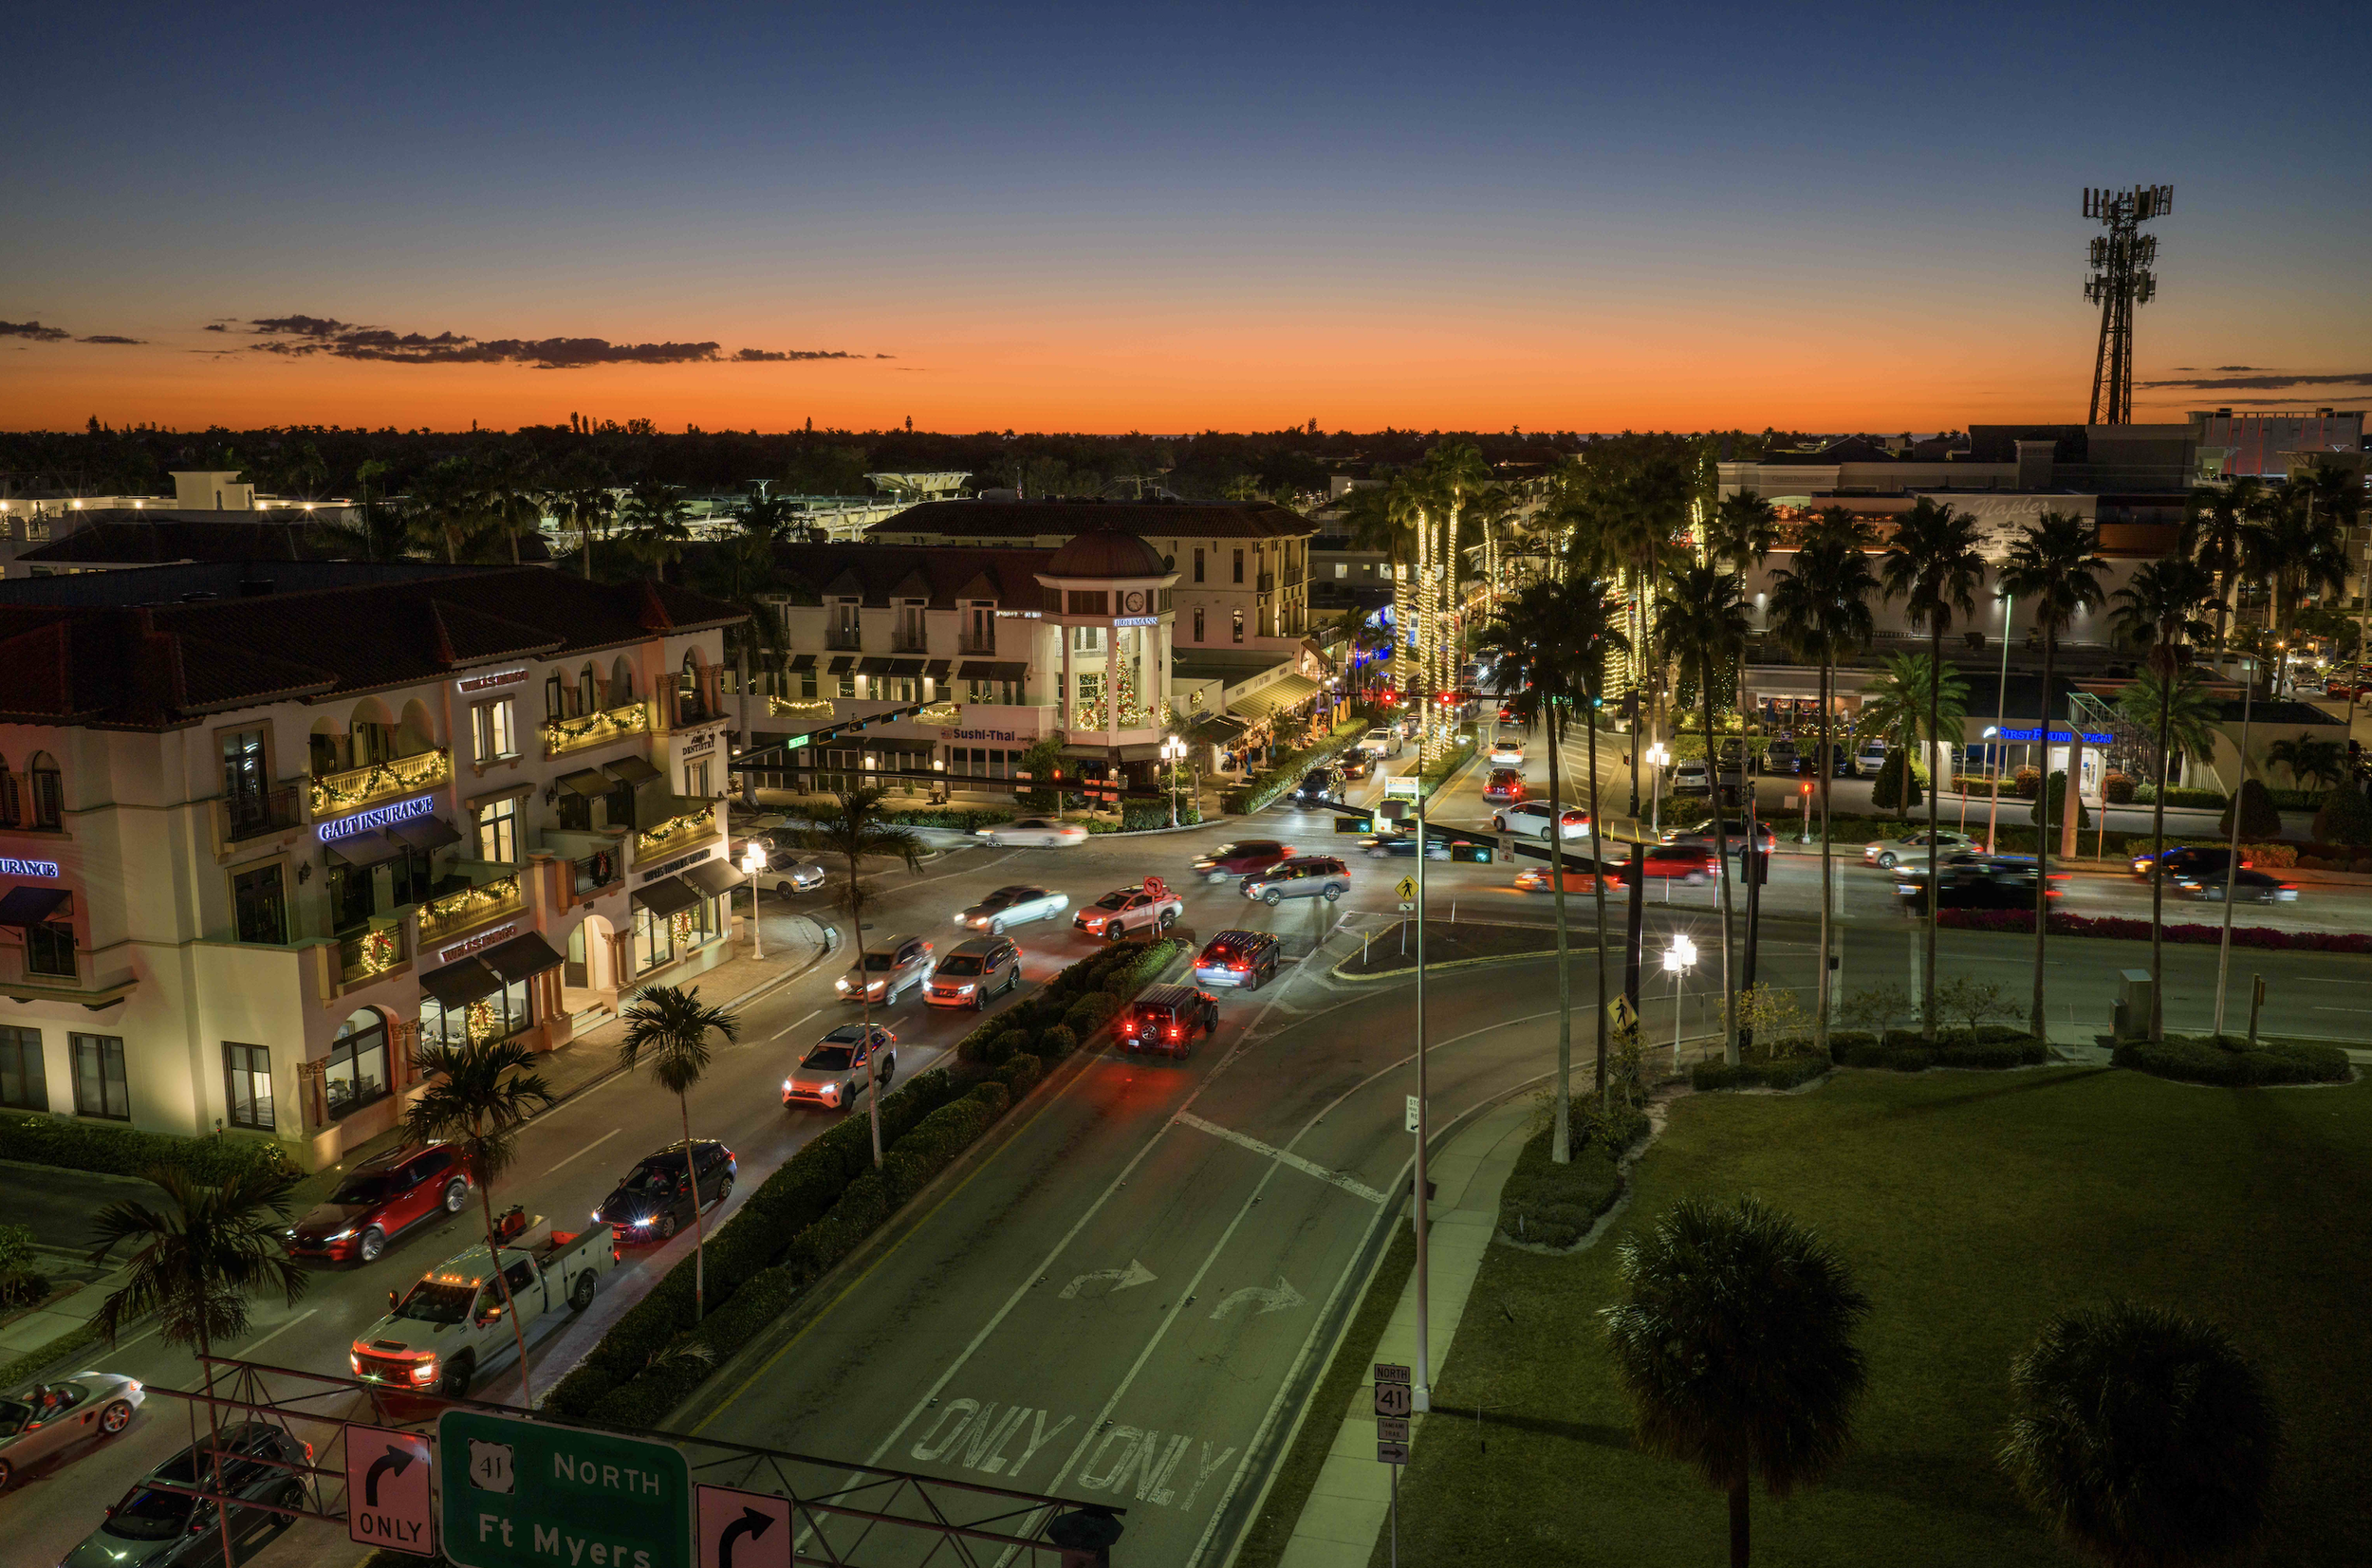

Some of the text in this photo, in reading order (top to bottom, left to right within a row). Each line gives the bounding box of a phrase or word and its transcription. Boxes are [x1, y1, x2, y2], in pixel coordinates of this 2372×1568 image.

[1974, 497, 2049, 519] Naples
[1114, 617, 1158, 626] HOFFMANN
[682, 741, 714, 756] DENTISTRY
[319, 796, 434, 840] GALT INSURANCE
[584, 901, 594, 912] 900
[440, 925, 517, 963] WELLS FARGO
[1377, 1367, 1408, 1379] NORTH
[1381, 1390, 1401, 1409] 41
[911, 1398, 1076, 1477] ONLY
[479, 1451, 660, 1496] 41 NORTH
[1078, 1425, 1237, 1511] ONLY
[360, 1512, 422, 1543] ONLY
[479, 1512, 651, 1568] Ft Myers
